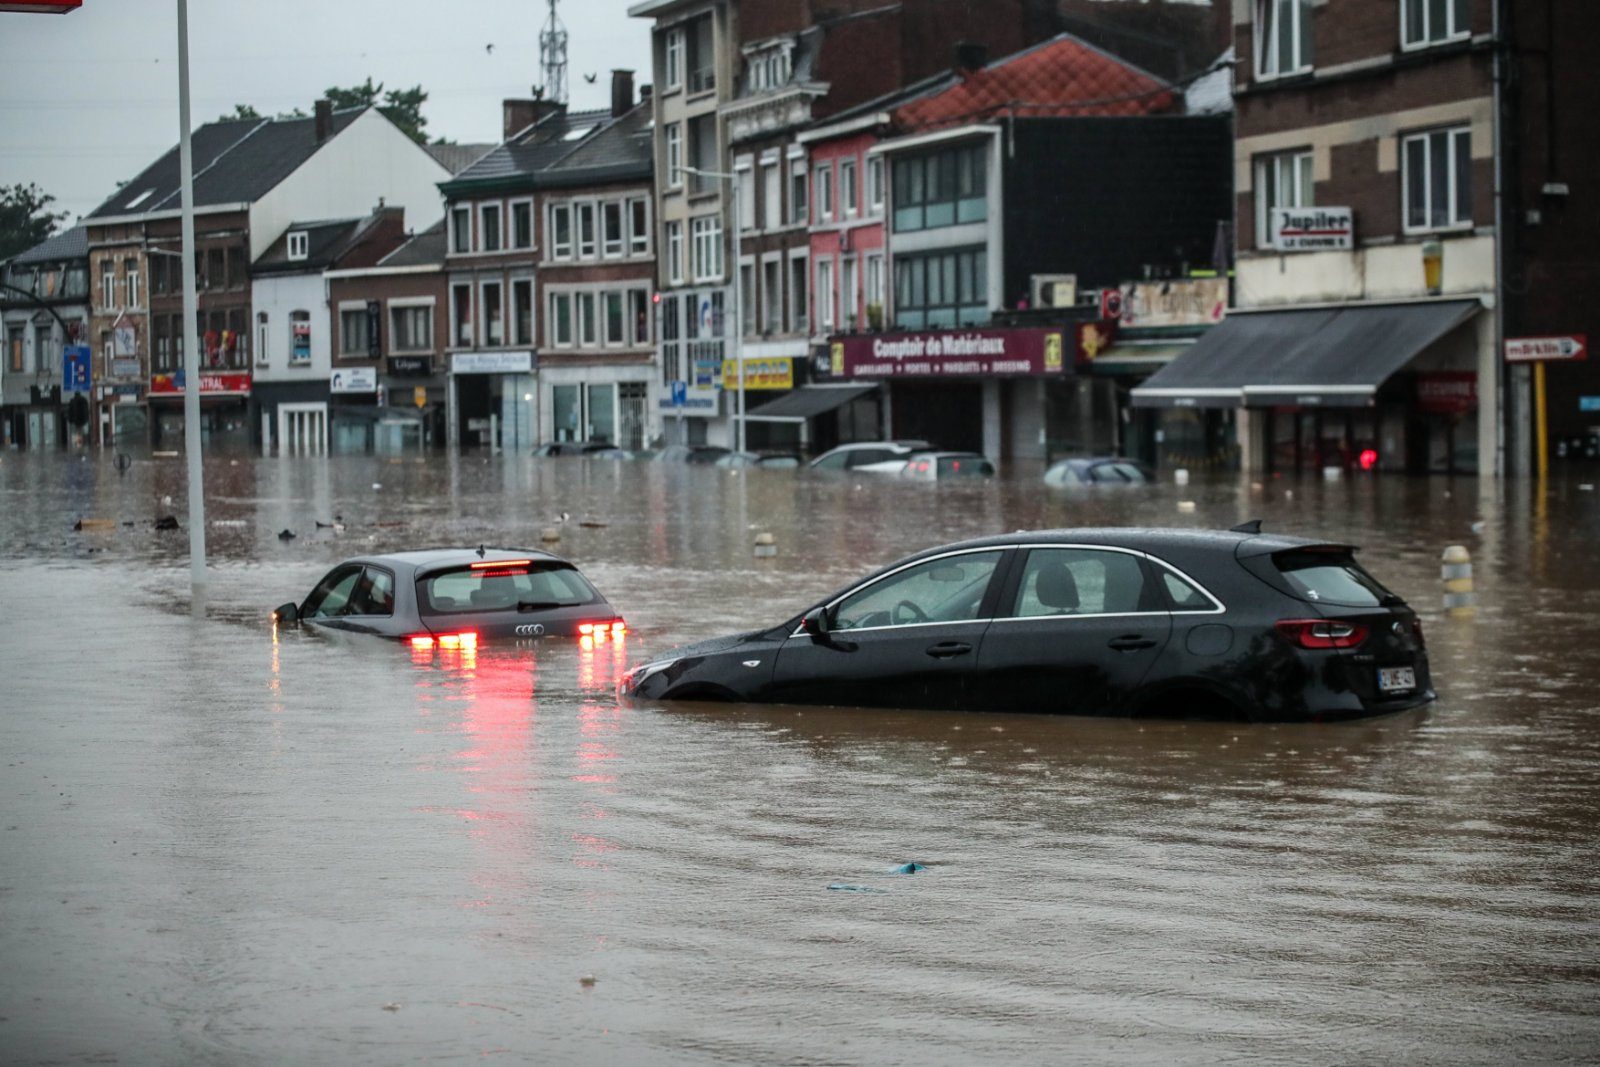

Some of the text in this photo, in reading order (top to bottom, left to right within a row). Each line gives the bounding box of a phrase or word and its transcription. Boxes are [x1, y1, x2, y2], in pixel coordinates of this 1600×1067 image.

[1282, 212, 1348, 230] Jupiler
[873, 334, 1005, 360] Comptoir de Matériaux
[674, 382, 684, 397] P
